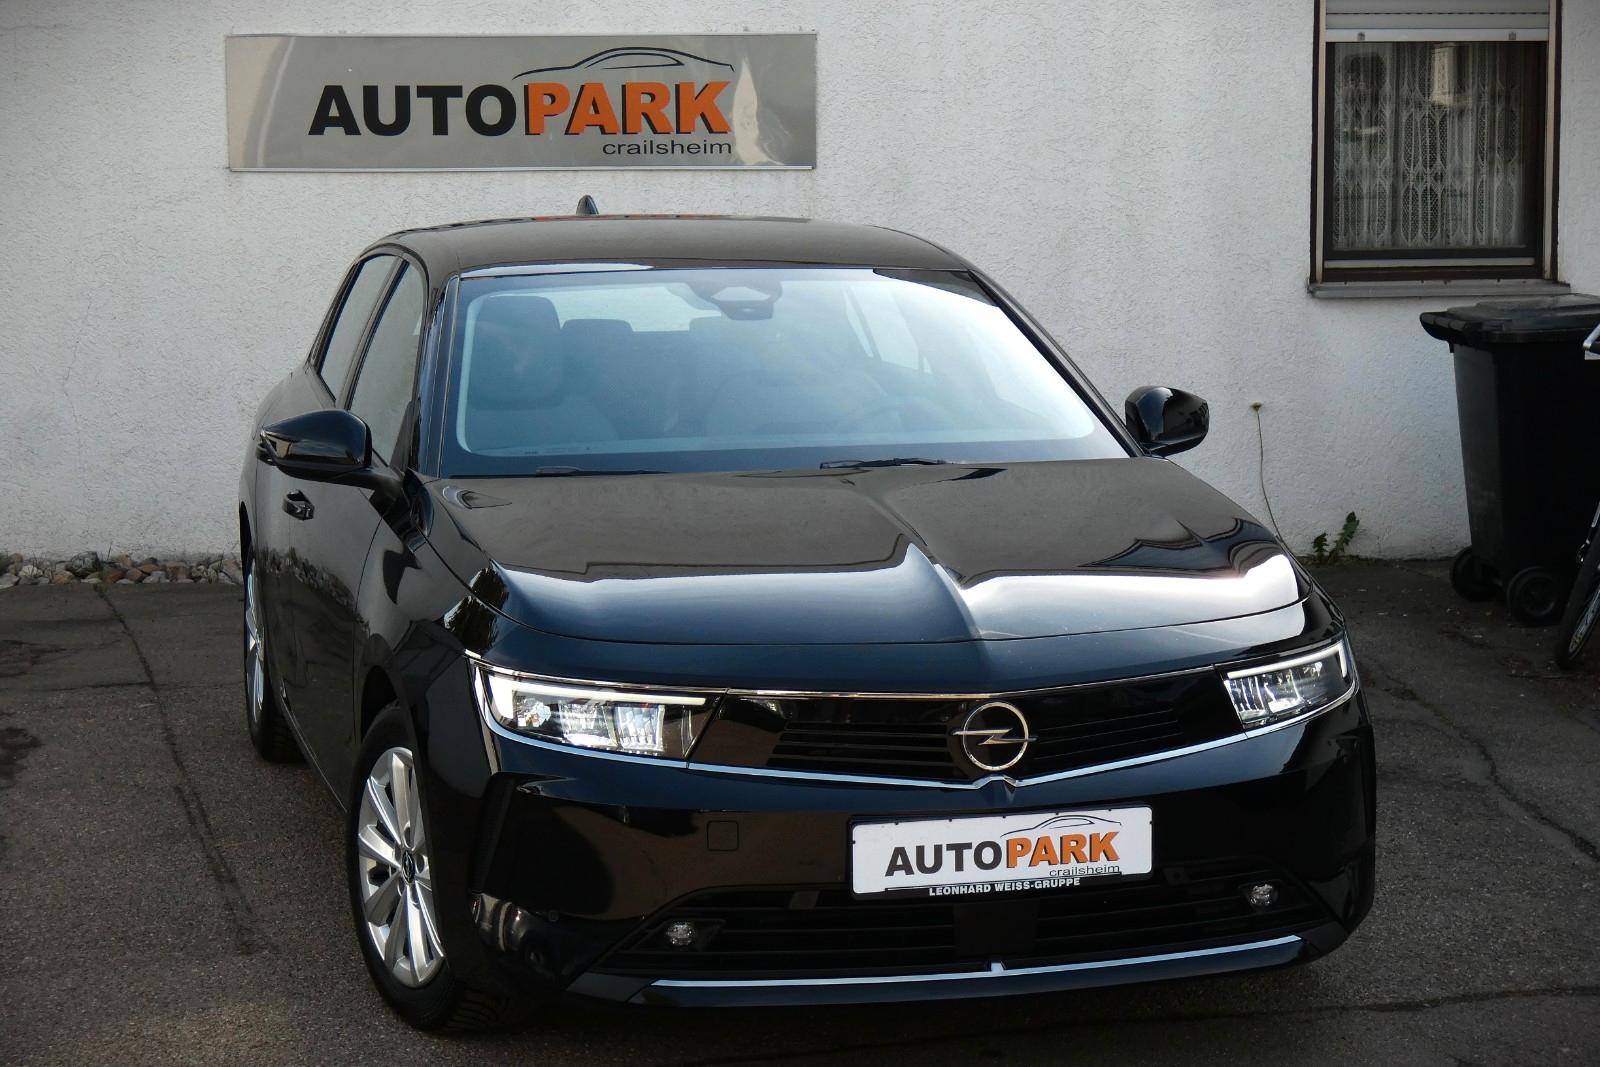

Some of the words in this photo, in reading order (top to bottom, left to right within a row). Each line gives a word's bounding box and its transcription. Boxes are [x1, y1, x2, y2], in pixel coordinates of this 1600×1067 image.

[308, 81, 732, 136] AUTOPARK
[602, 139, 732, 155] crailsheim
[885, 832, 1120, 876] AUTOPARK
[1049, 865, 1120, 877] crailsheim
[929, 884, 992, 896] LEONHARD
[994, 878, 1081, 892] WEISS-GRUPPE
